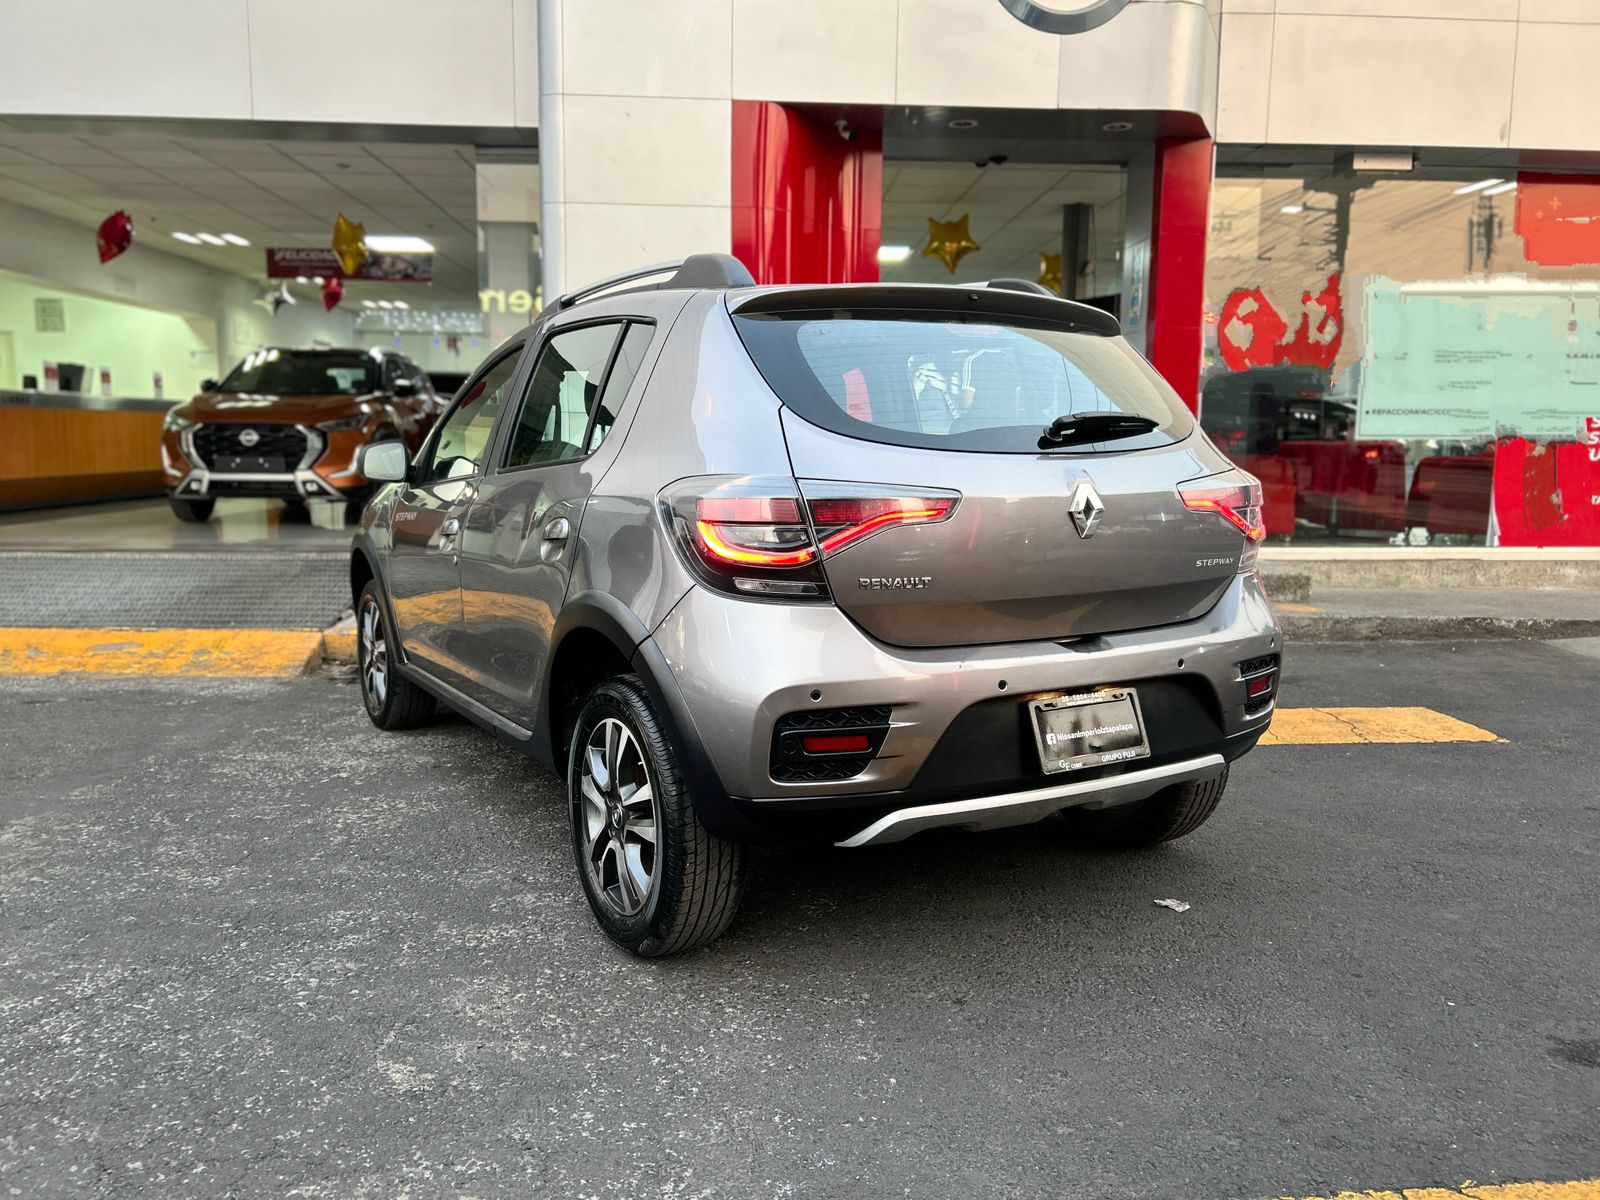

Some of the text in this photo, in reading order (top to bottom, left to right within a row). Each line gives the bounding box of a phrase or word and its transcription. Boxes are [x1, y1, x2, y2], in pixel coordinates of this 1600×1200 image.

[1195, 557, 1235, 568] STEPWAY
[858, 576, 932, 590] RENAULT
[1101, 750, 1136, 763] GRUPO FUJI
